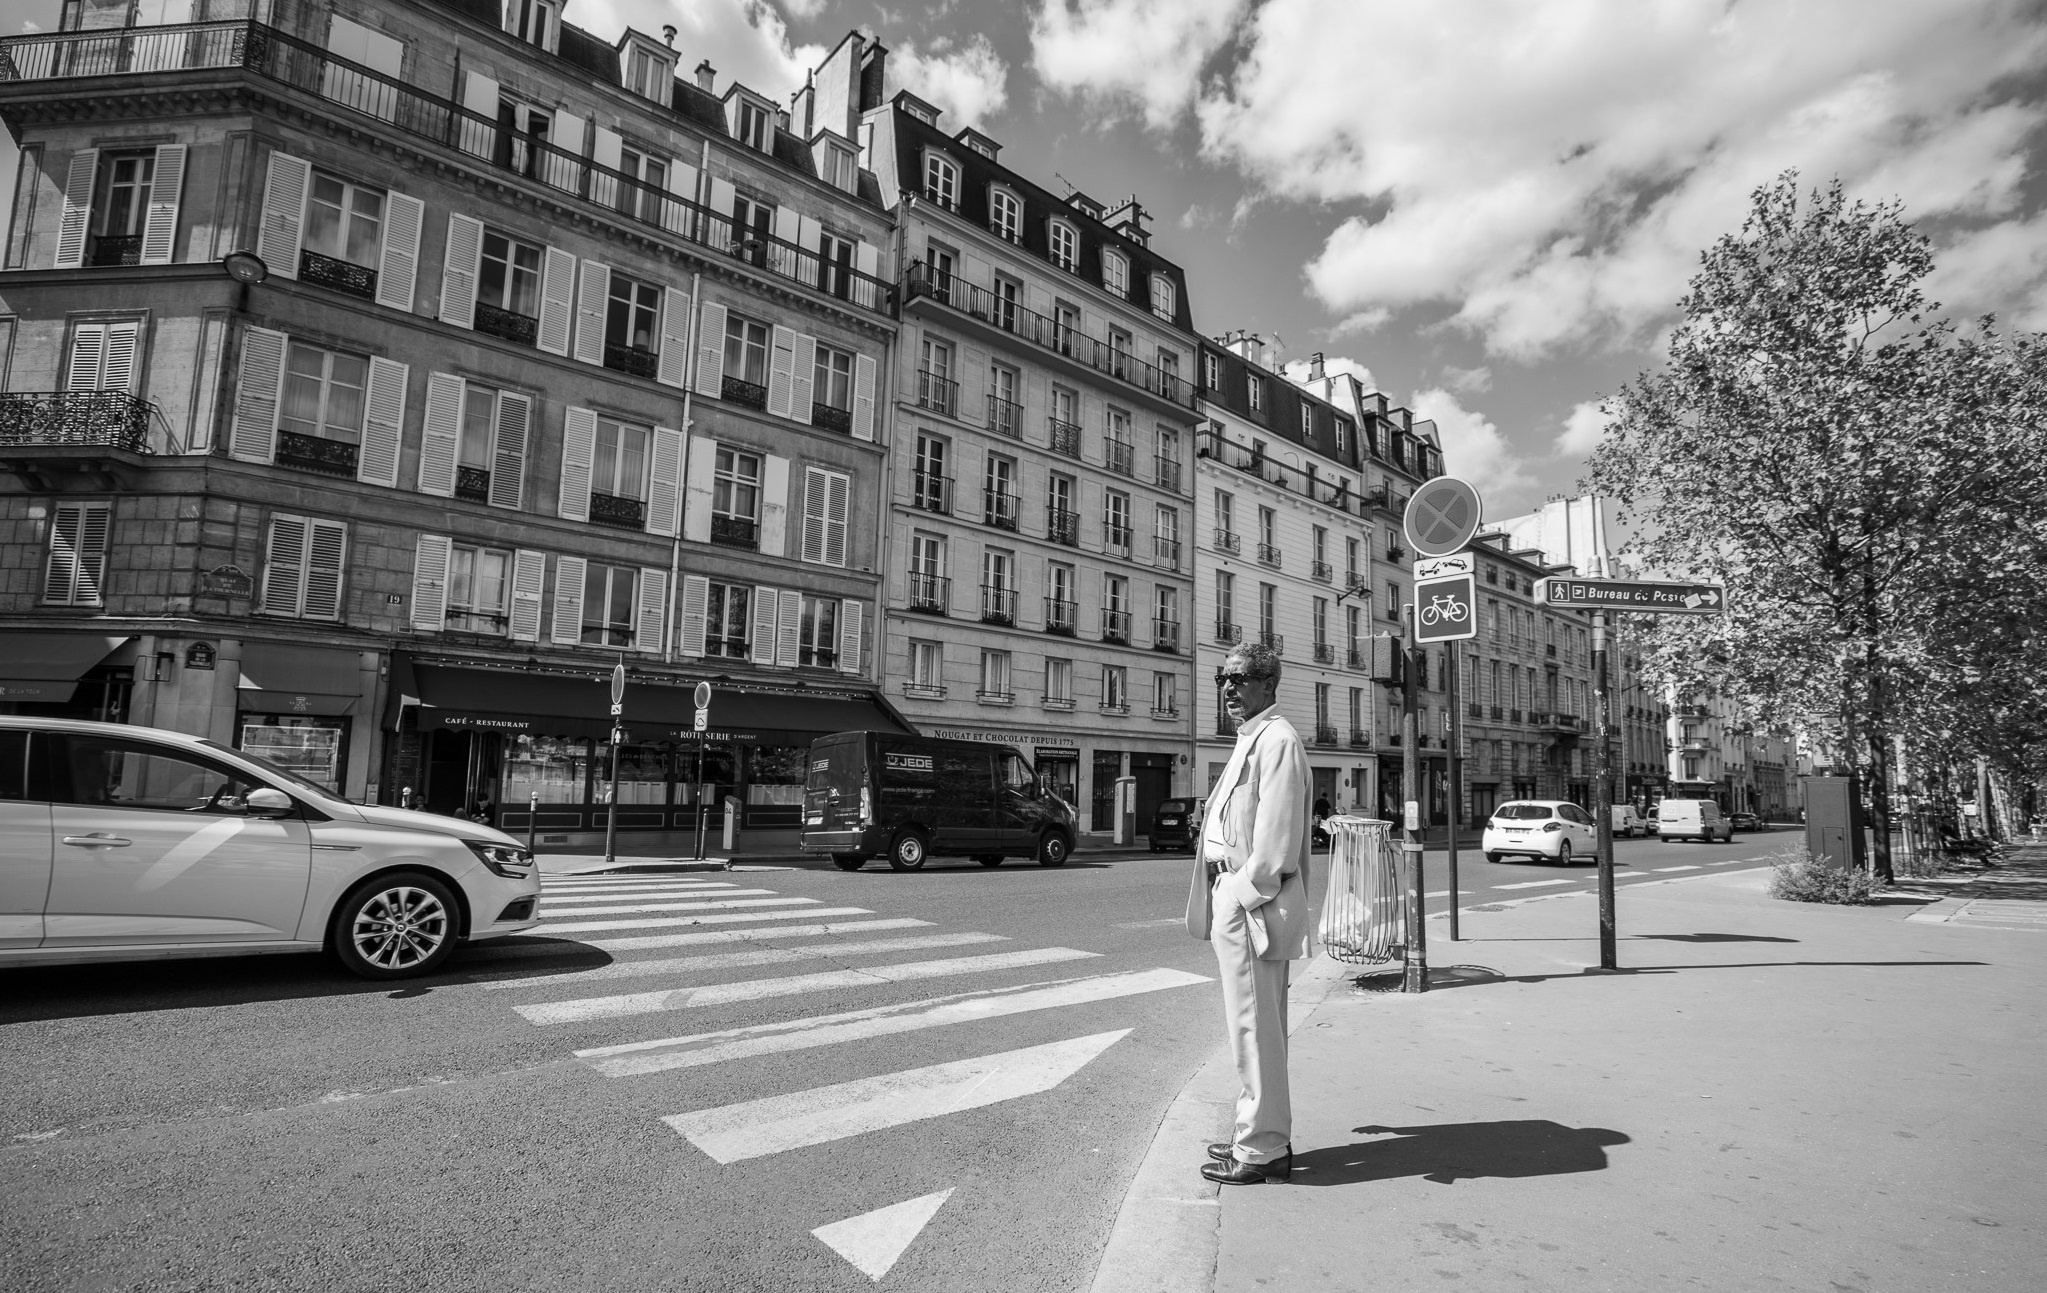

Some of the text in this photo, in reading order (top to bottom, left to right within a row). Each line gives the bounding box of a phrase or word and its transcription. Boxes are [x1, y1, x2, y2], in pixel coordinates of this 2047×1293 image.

[389, 595, 400, 604] 19
[1588, 587, 1630, 600] Bureau
[444, 716, 468, 725] CAFÉ
[476, 719, 530, 729] RESTAURANT
[680, 730, 731, 741] RÔTISERIE
[934, 730, 1074, 746] NOUGAT ET CHOCOLAT DEPUIS 1775
[900, 757, 933, 769] JEDE
